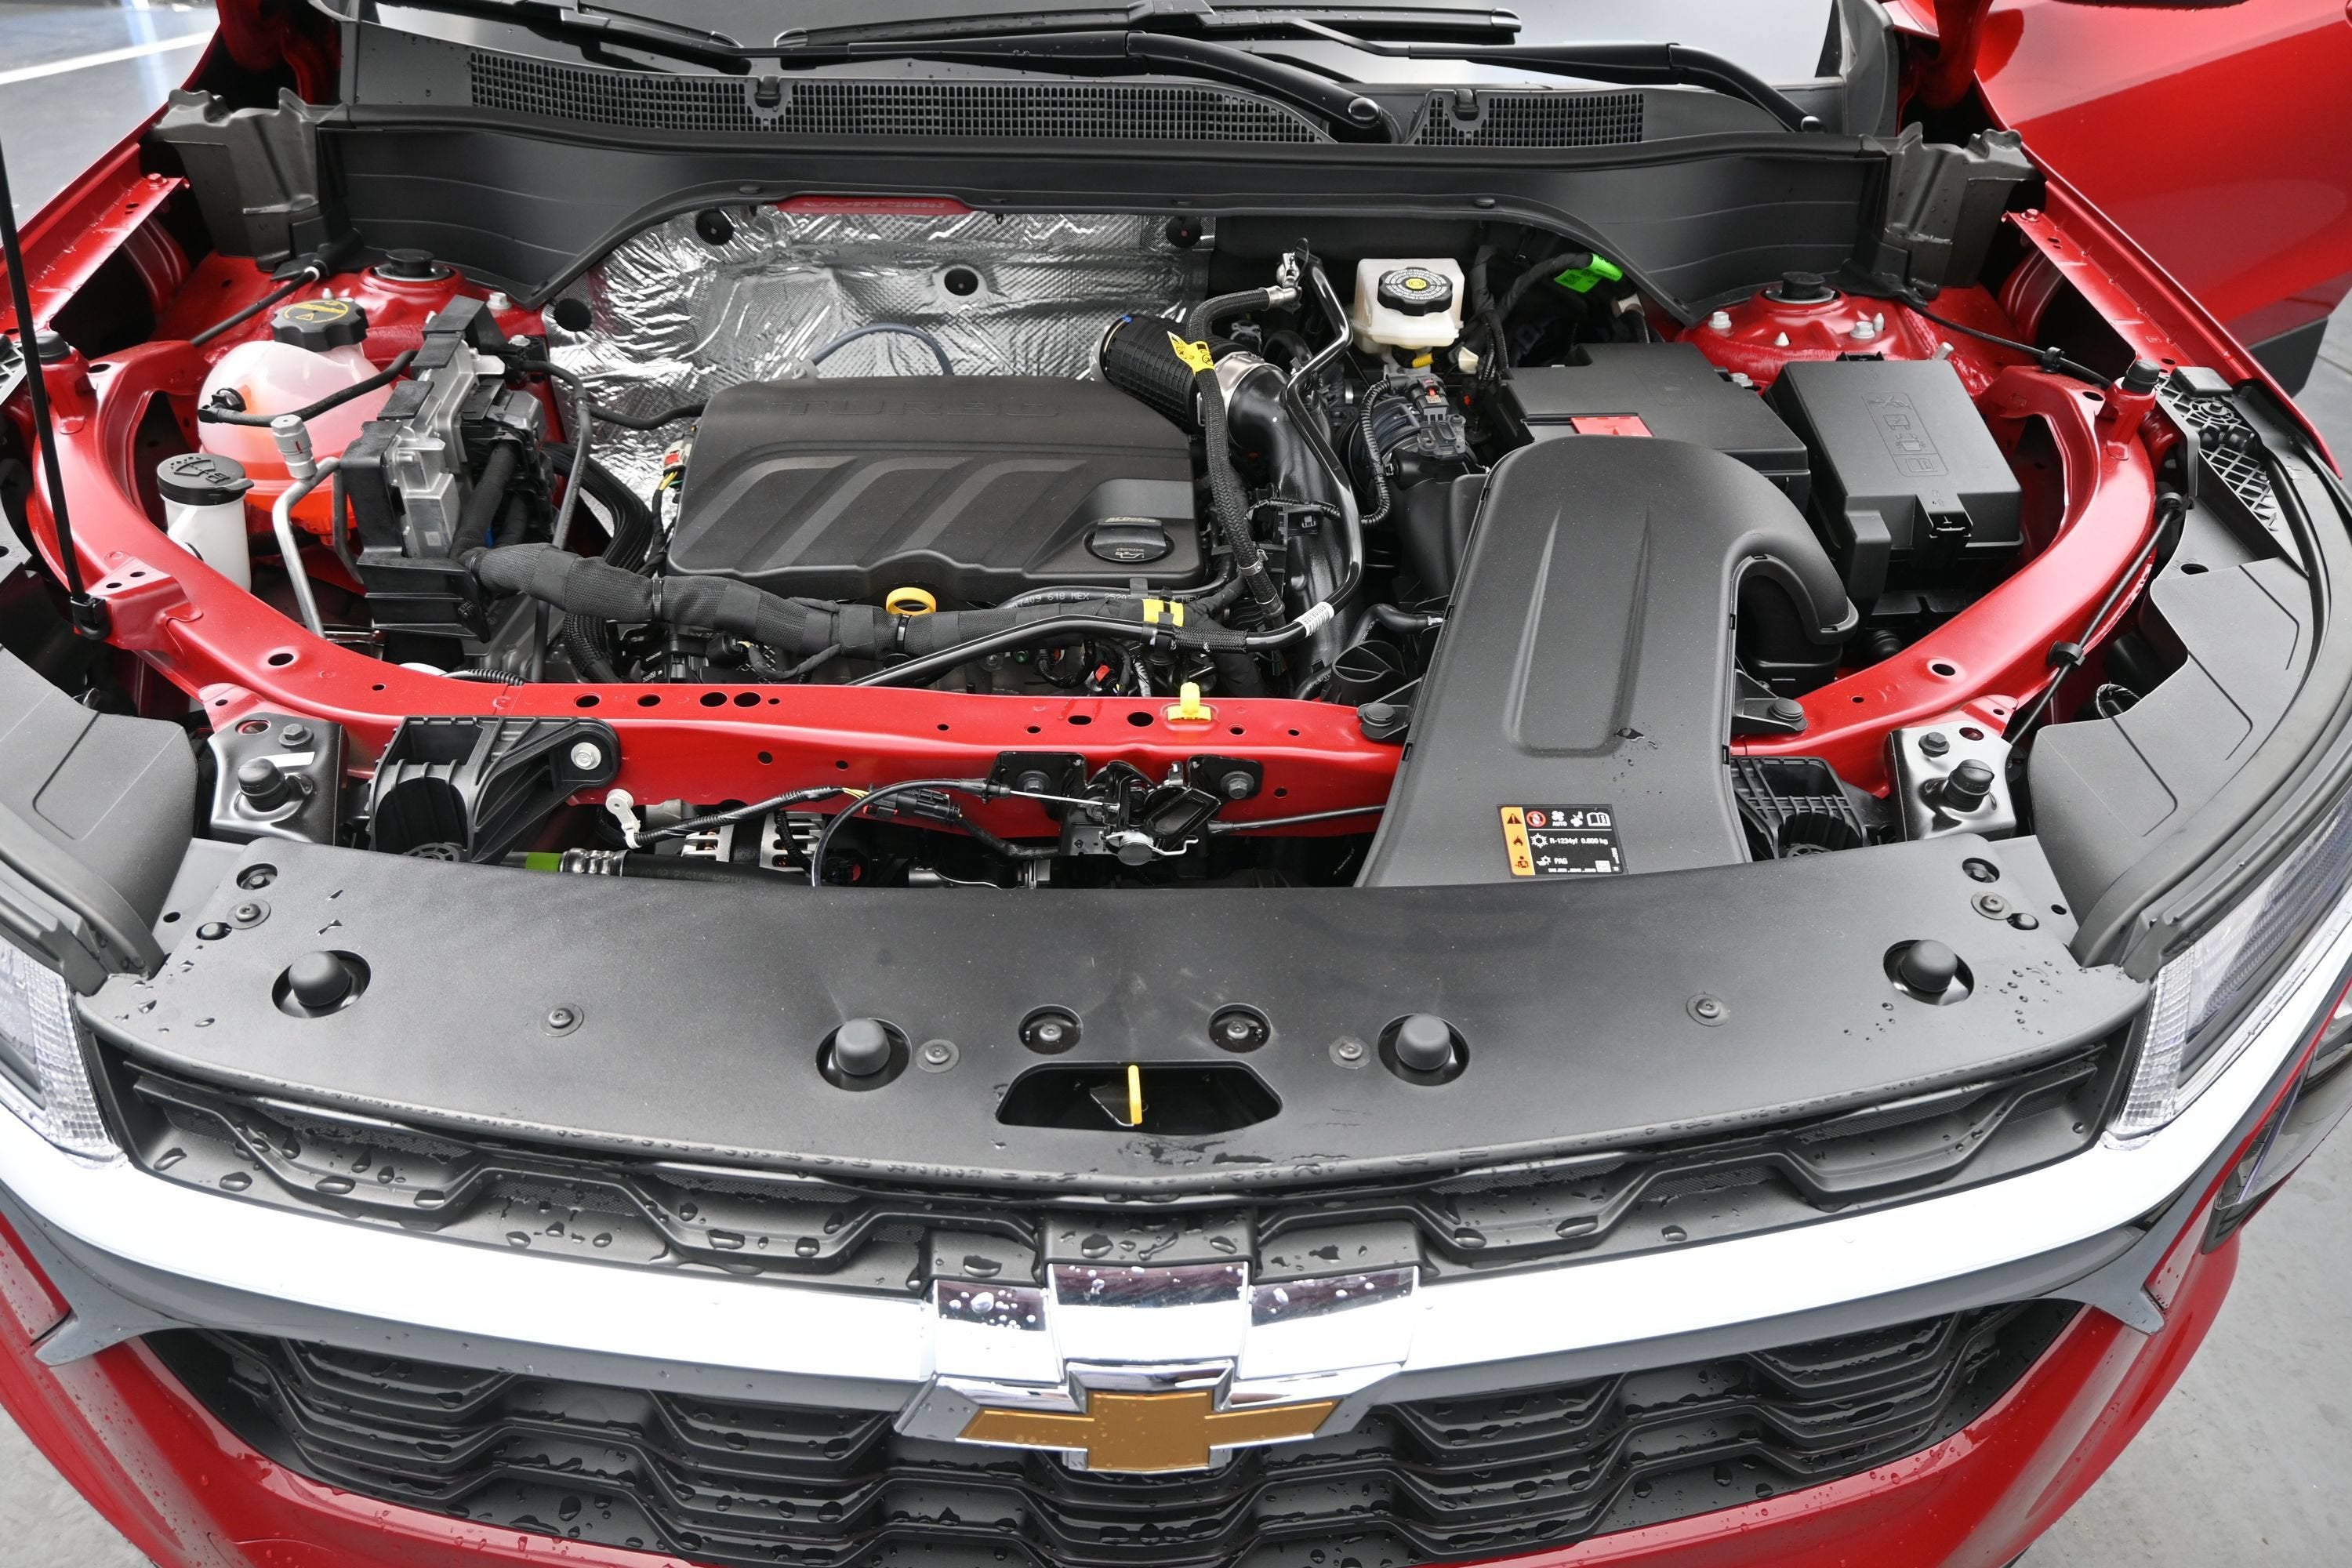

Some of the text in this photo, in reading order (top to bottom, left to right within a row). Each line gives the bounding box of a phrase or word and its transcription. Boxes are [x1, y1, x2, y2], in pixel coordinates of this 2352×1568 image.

[772, 401, 1061, 416] TURBO
[1047, 592, 1065, 601] 618
[1070, 592, 1091, 601] MEX
